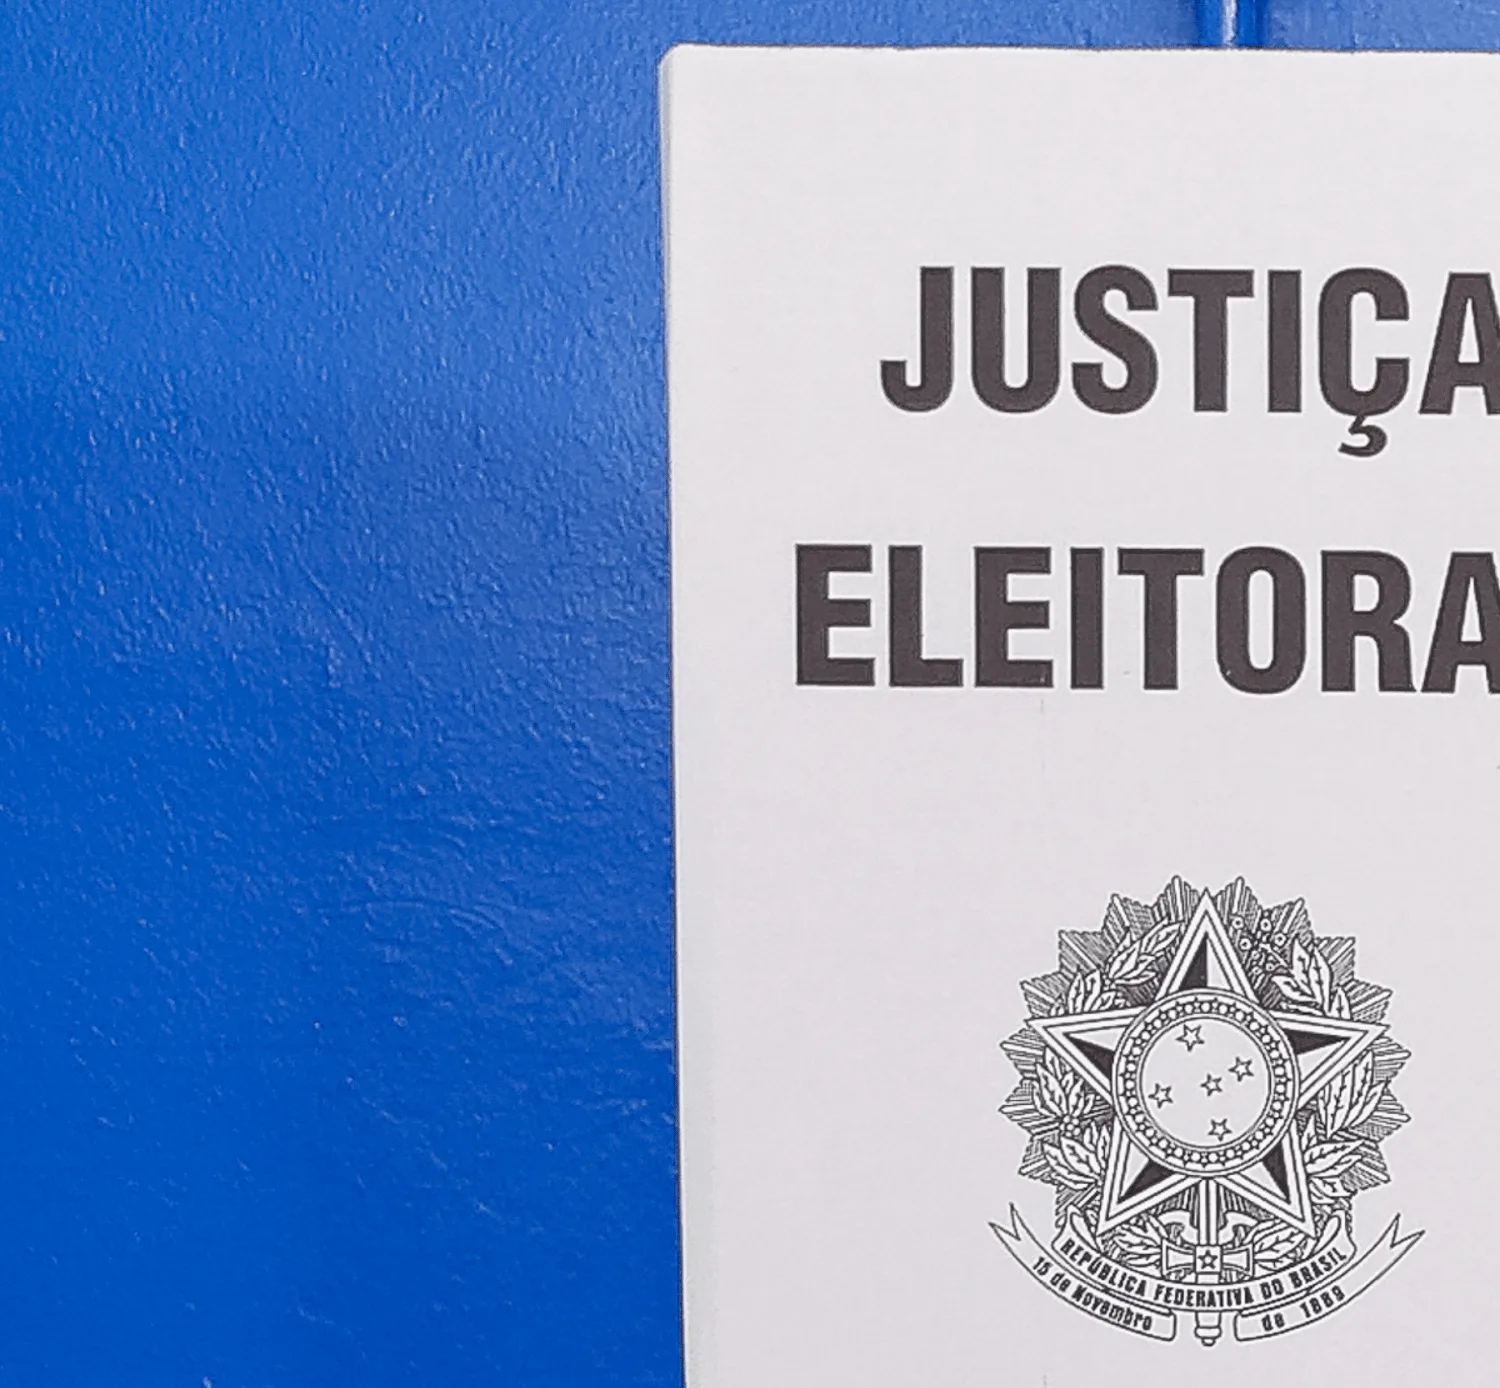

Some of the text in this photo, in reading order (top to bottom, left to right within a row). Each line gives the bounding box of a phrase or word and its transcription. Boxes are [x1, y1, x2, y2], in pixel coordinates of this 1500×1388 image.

[1032, 1256, 1346, 1332] 15 de Novembro de 1889
[1060, 1238, 1347, 1308] REPÚBLICA FEDERATIVA DO BRASIL
